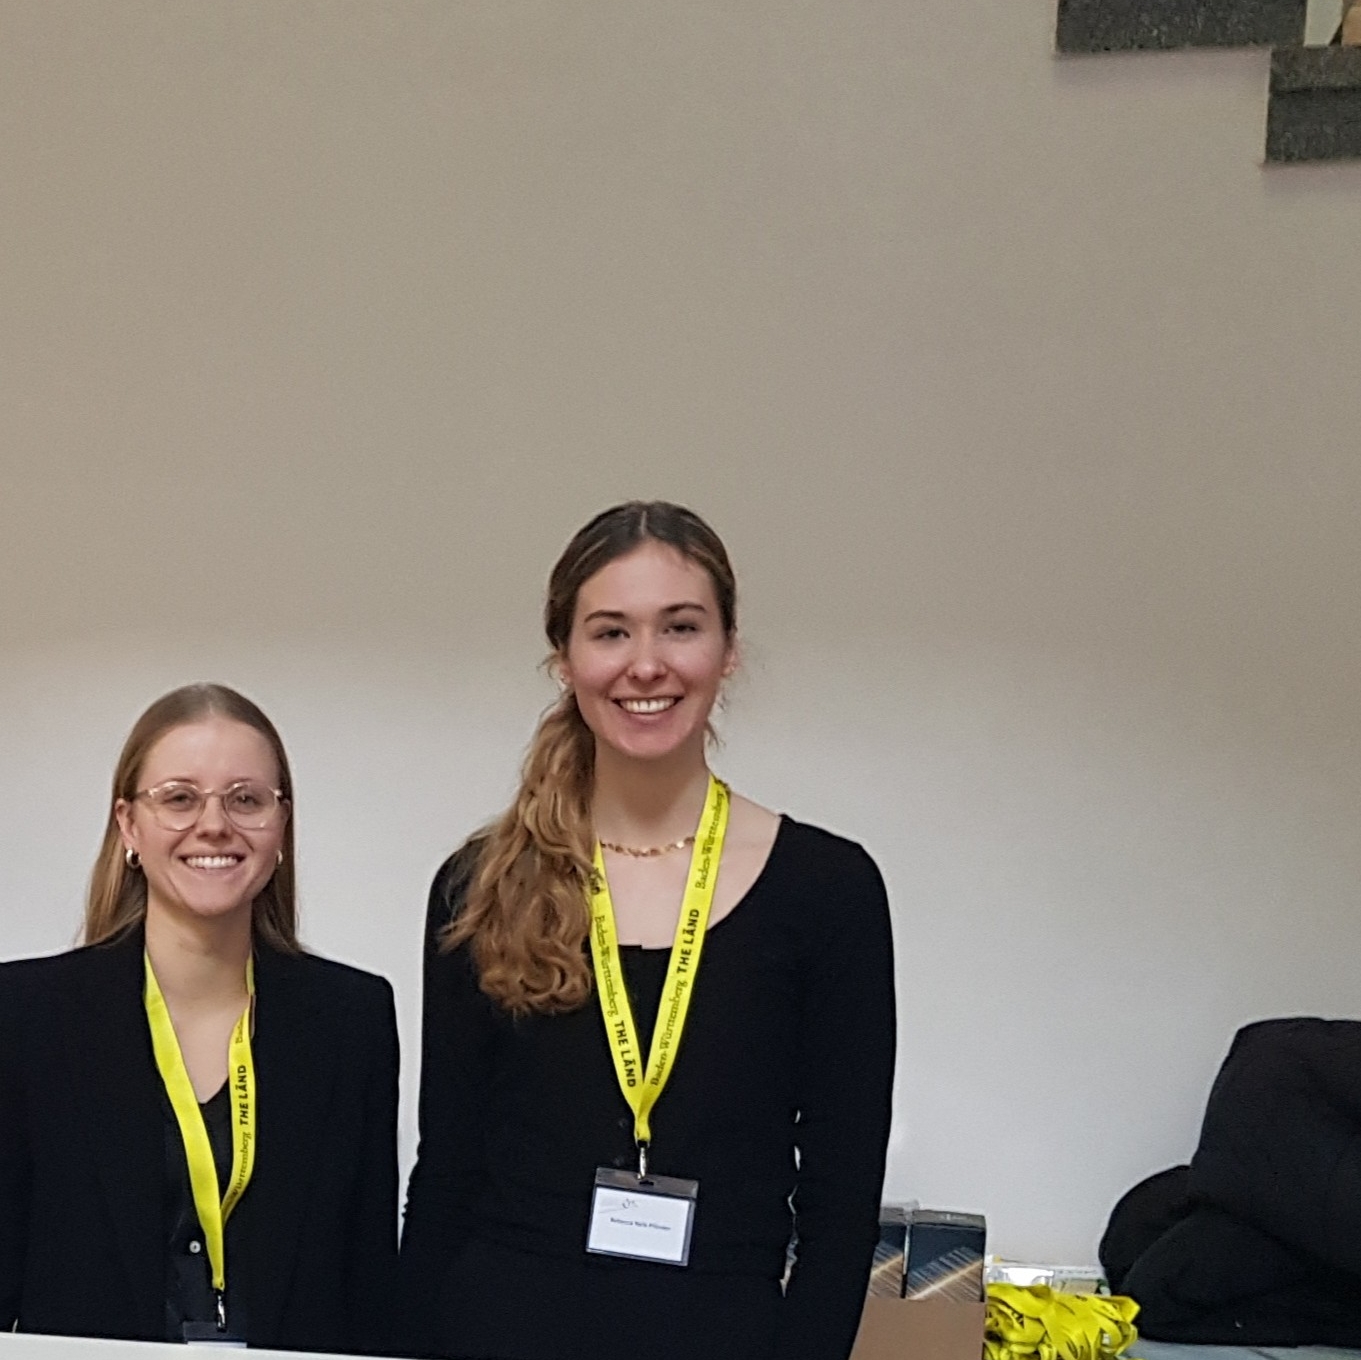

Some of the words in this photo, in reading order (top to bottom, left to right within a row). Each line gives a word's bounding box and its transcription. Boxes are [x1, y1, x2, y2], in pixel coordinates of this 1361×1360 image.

[677, 944, 693, 975] THE
[614, 1020, 629, 1046] THE
[238, 1103, 249, 1126] THE
